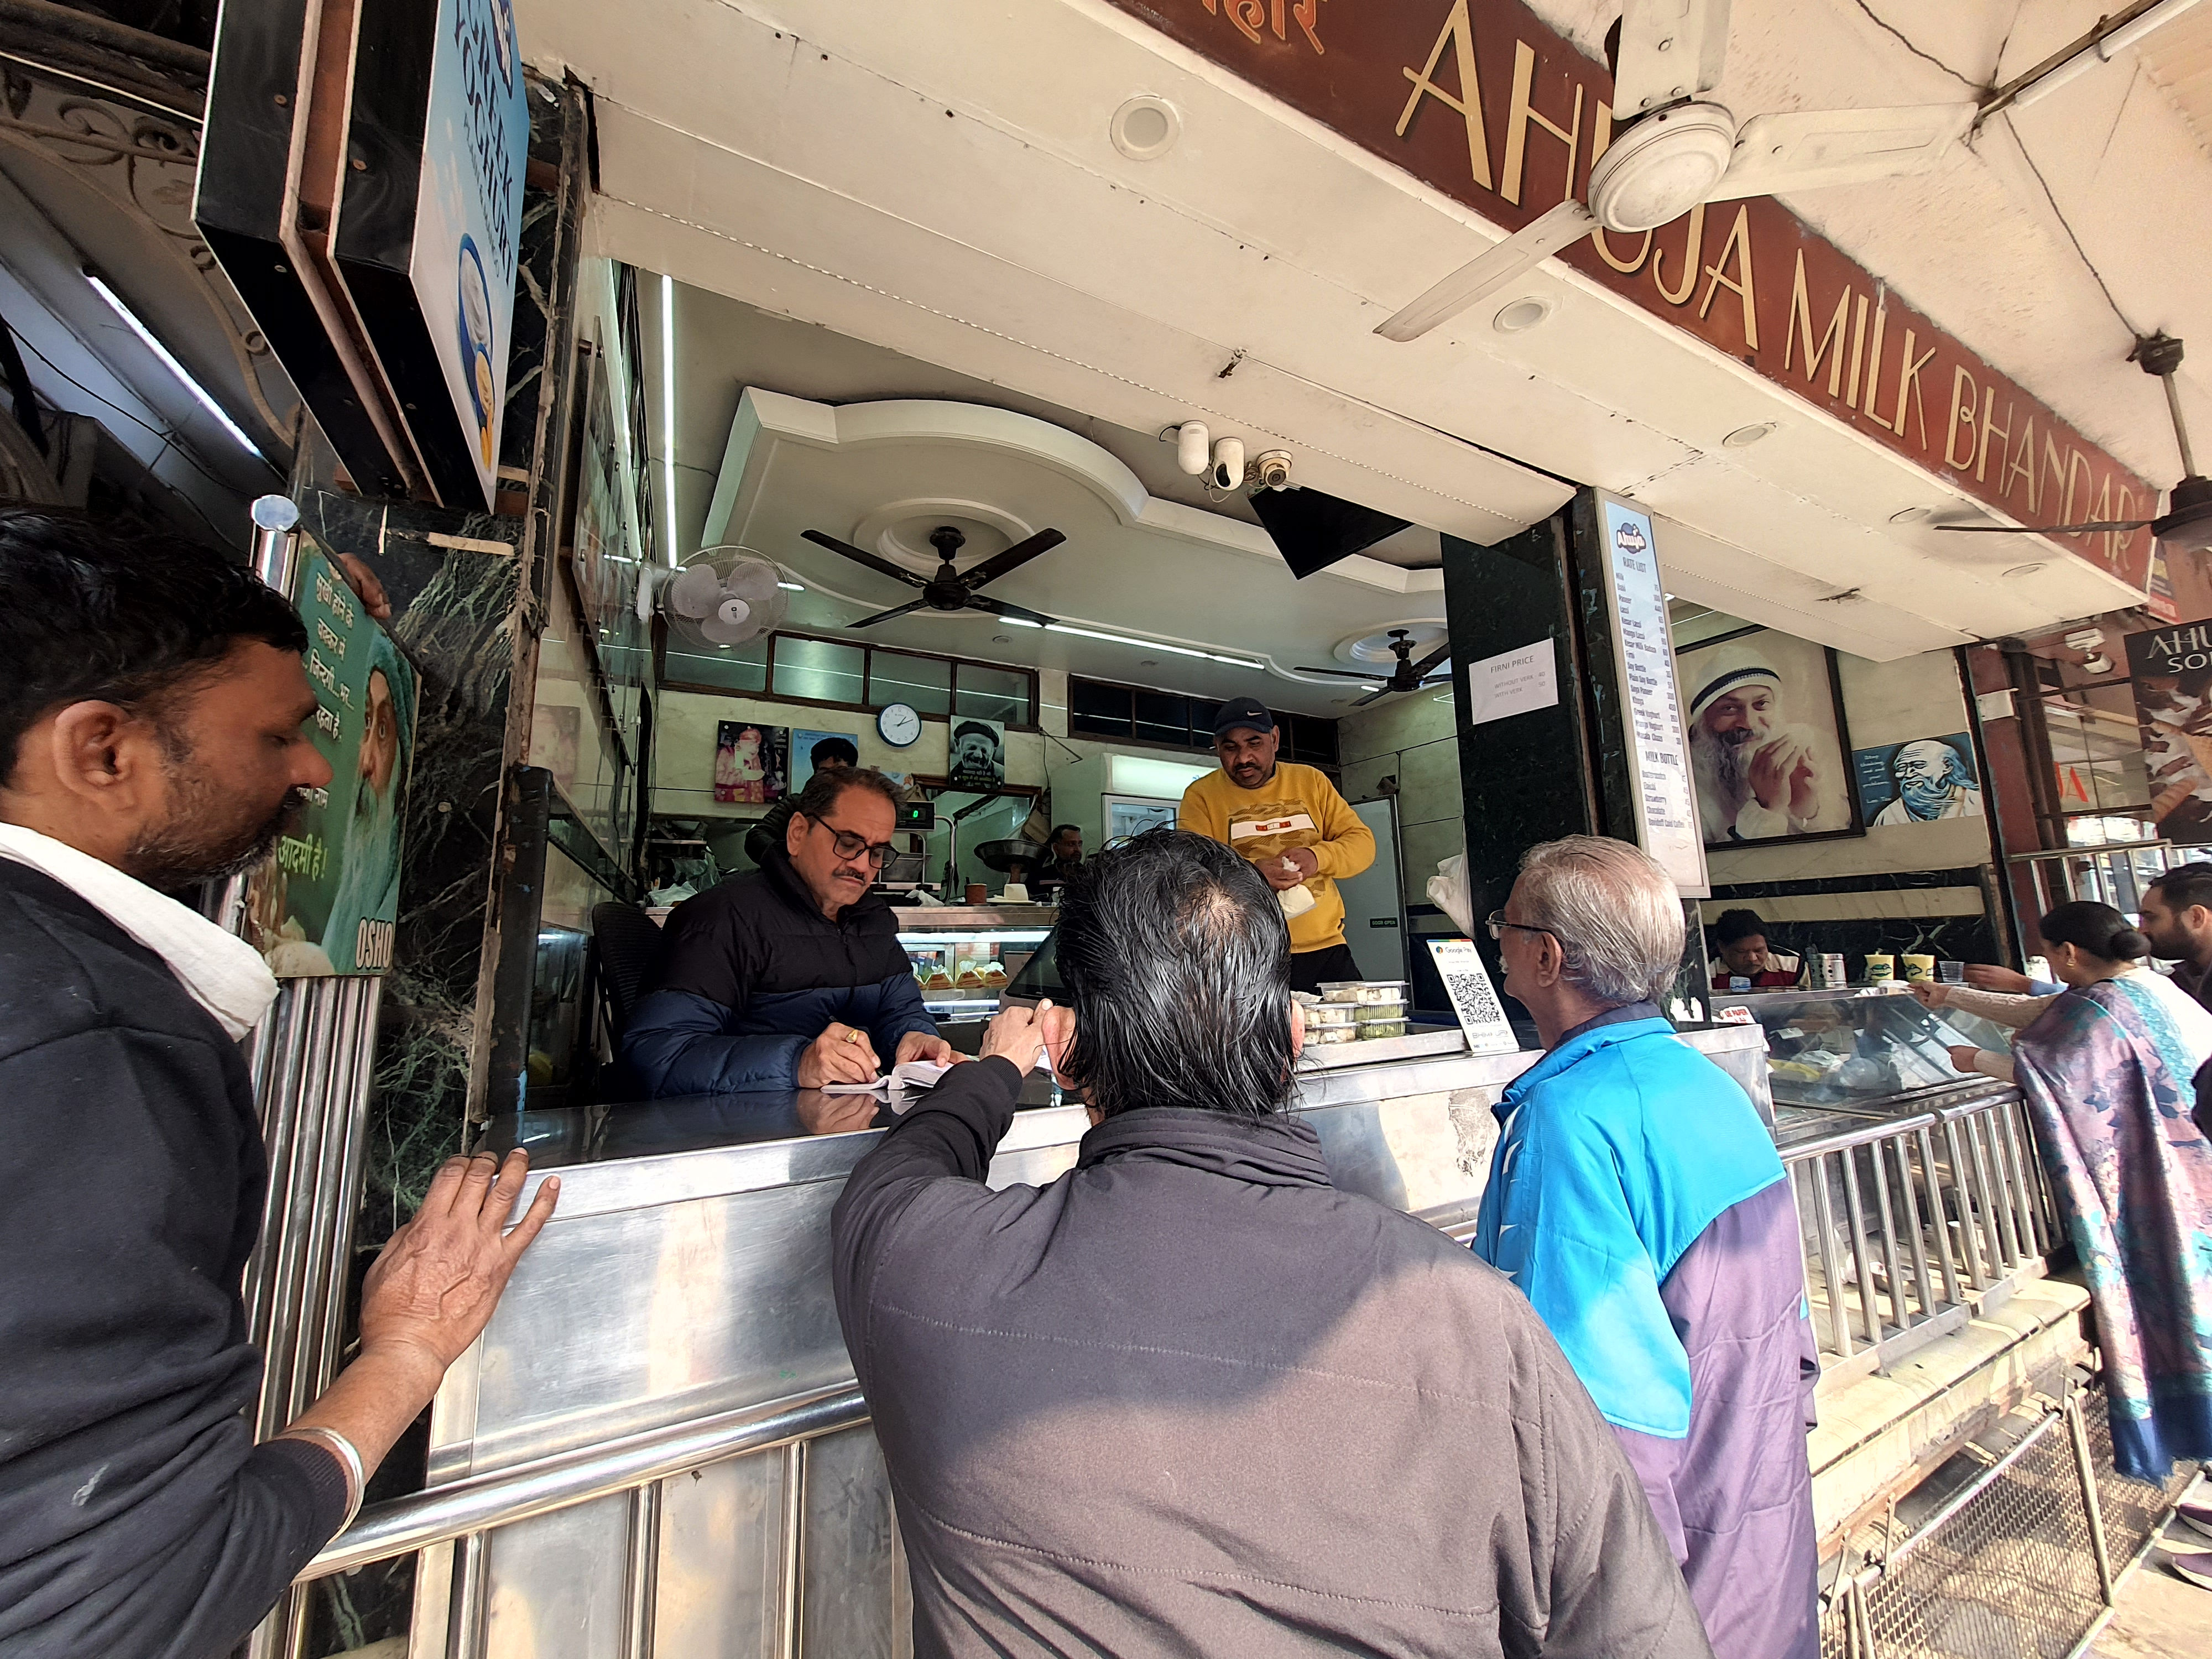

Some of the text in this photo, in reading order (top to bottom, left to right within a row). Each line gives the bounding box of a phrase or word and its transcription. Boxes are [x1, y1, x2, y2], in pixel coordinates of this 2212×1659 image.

[1784, 247, 1936, 451] MILK
[1945, 364, 2137, 571] BHANDAR
[1623, 556, 1646, 573] RATE LIST
[1490, 655, 1535, 674] FIRNI PRICE
[2168, 651, 2212, 674] SO
[1494, 678, 1519, 689] WITHOUT
[1520, 674, 1534, 682] VERK
[1495, 690, 1509, 698] WITH
[1645, 751, 1679, 766] MILK BOTTLE
[913, 810, 919, 818] 0
[278, 833, 313, 875] आदमी
[356, 917, 393, 970] OSHO
[1445, 946, 1463, 954] Google
